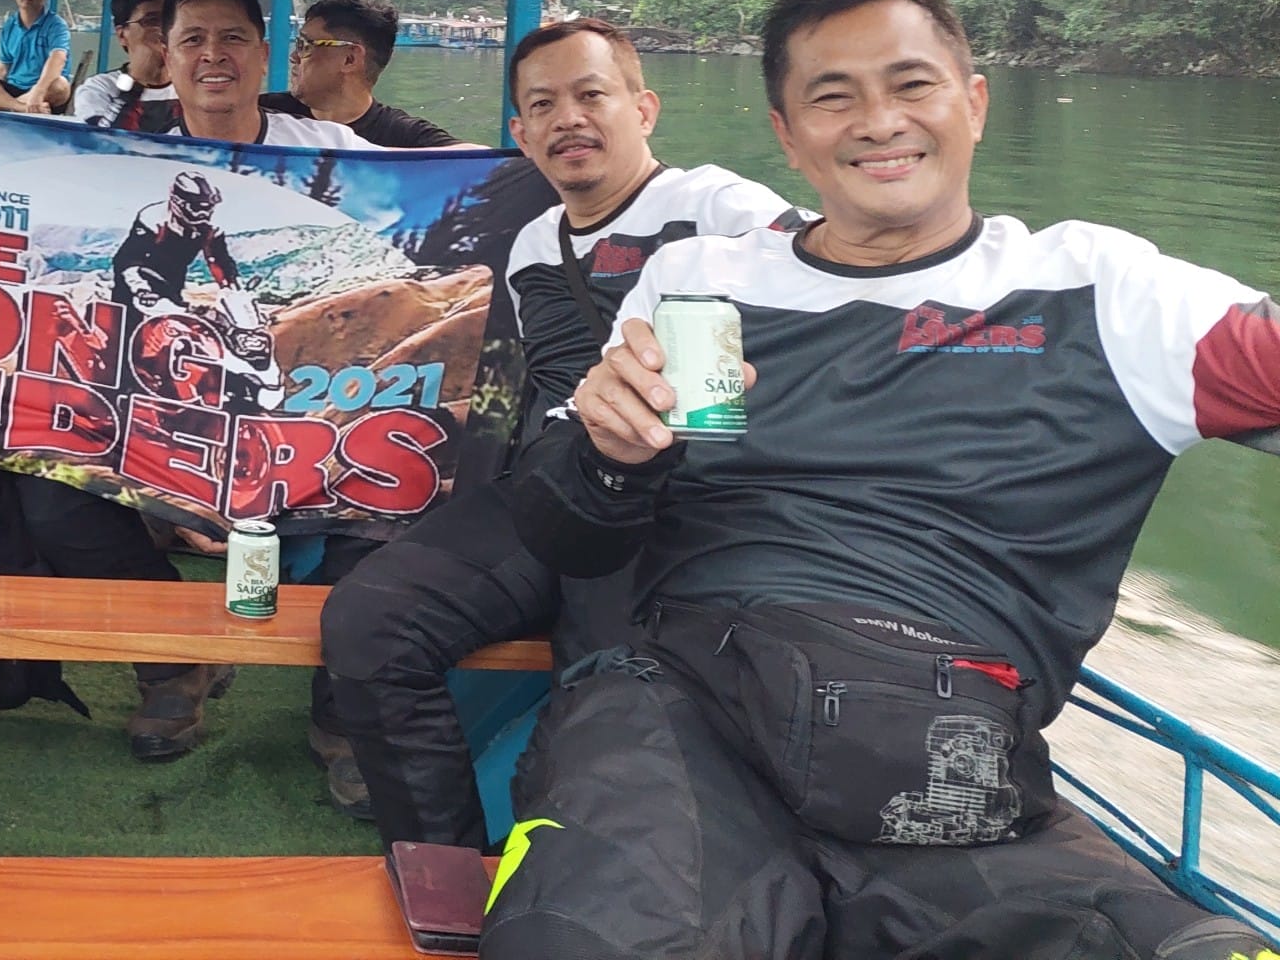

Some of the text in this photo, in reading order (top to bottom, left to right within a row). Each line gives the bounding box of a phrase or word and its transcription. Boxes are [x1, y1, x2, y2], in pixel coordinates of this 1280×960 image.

[284, 362, 446, 412] 2021
[852, 617, 983, 648] BMW Motor
